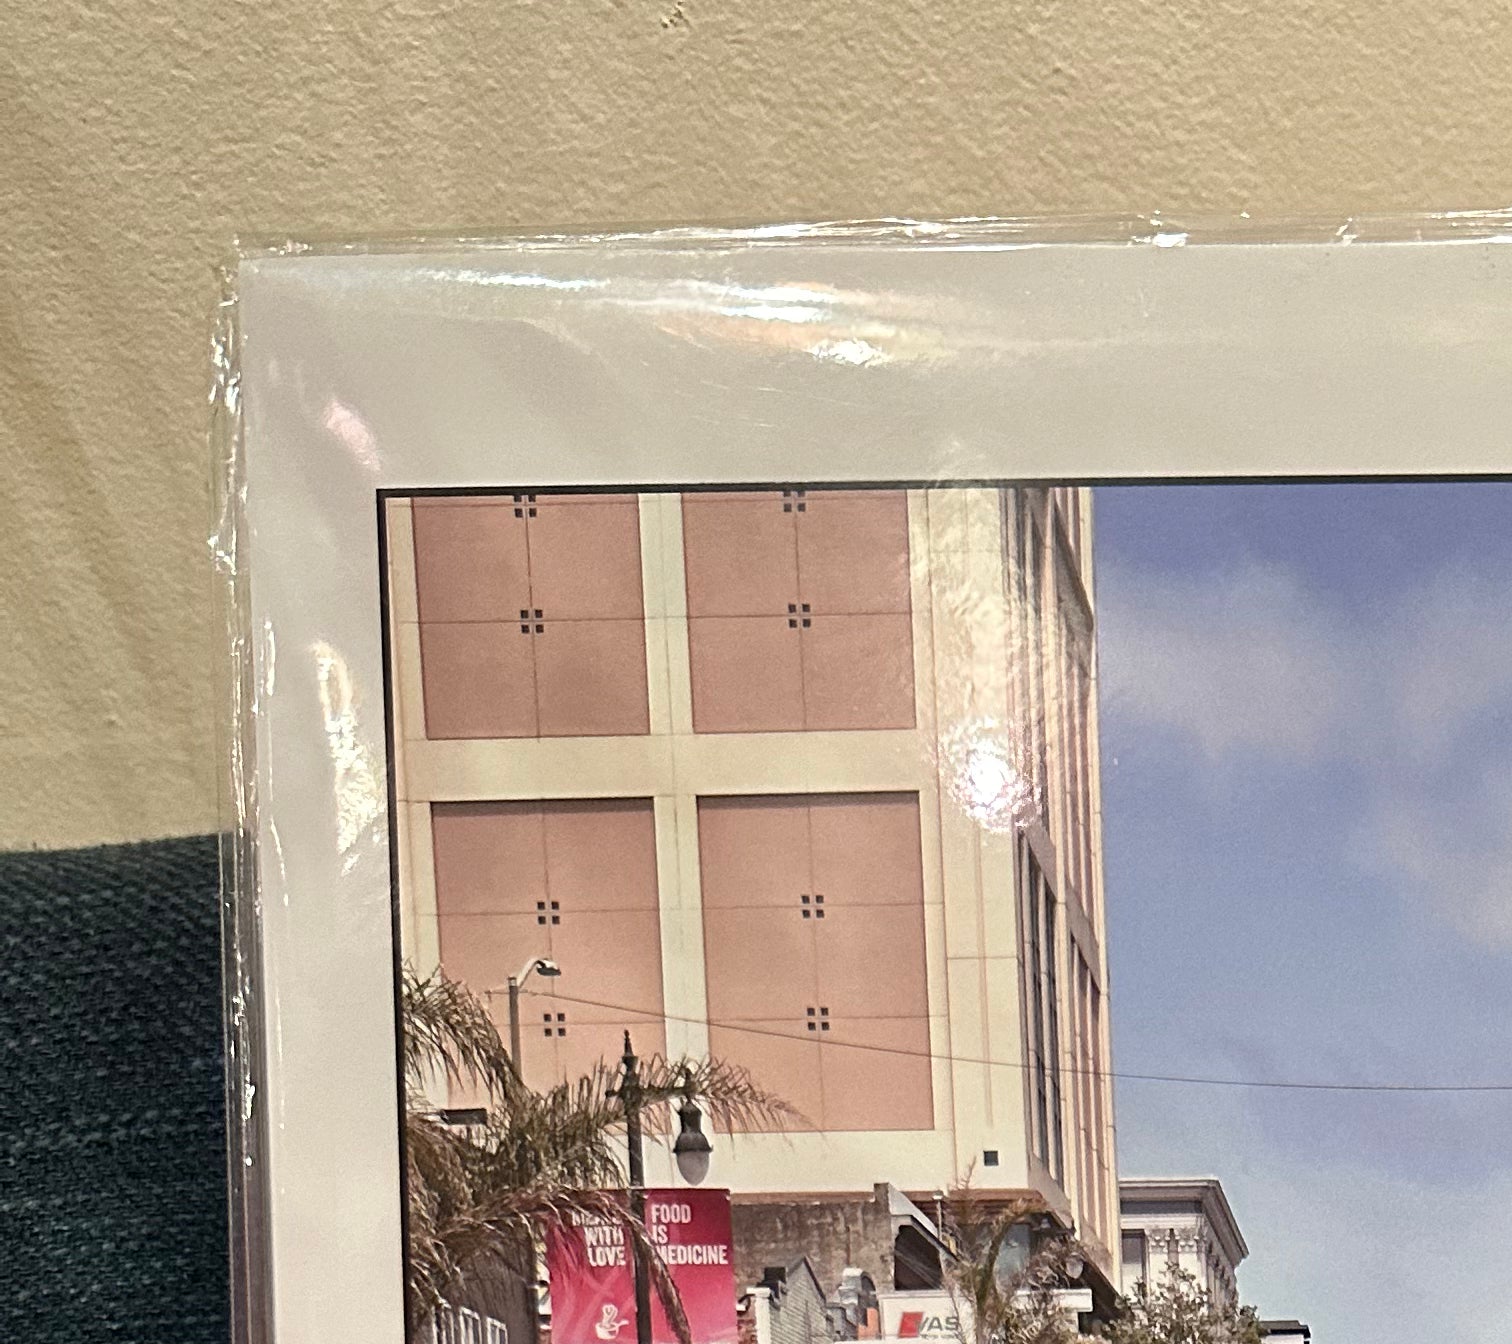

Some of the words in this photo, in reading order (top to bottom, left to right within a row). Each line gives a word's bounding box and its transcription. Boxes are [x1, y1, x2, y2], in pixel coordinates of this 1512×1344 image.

[651, 1204, 691, 1223] FOOD
[584, 1226, 624, 1245] WITH
[651, 1225, 668, 1244] IS
[588, 1246, 626, 1267] LOVE
[655, 1245, 728, 1265] MEDICINE
